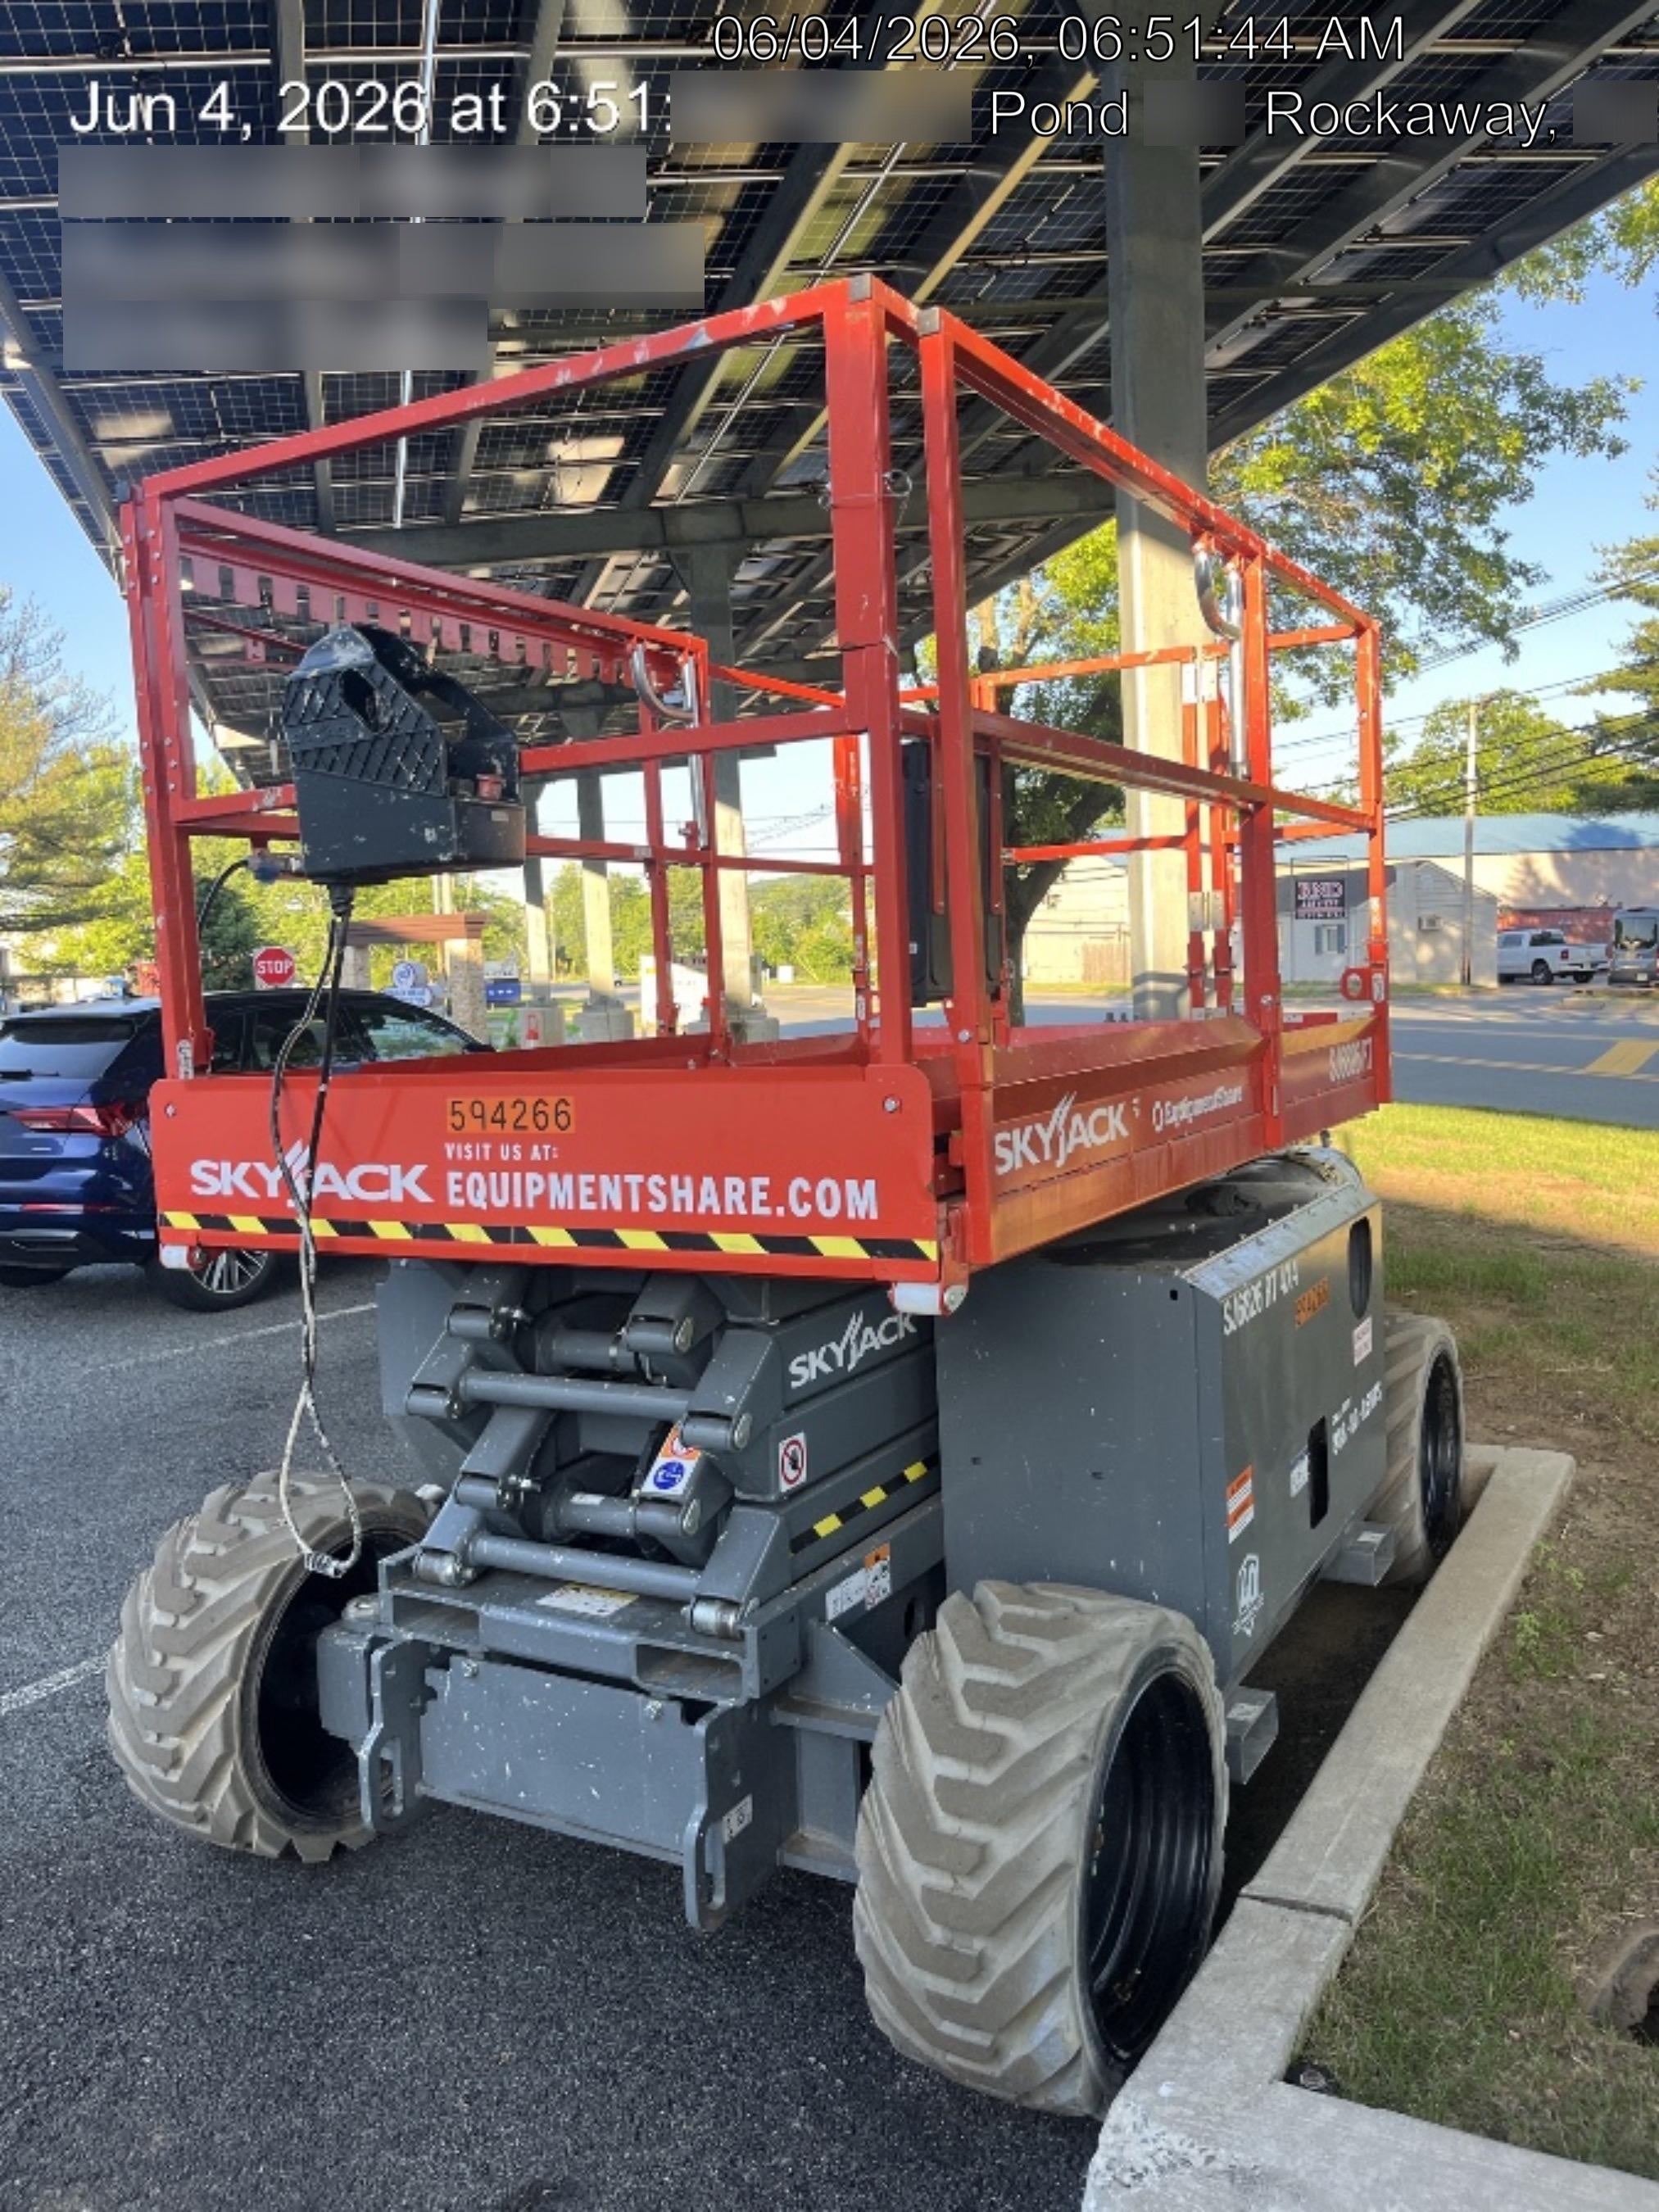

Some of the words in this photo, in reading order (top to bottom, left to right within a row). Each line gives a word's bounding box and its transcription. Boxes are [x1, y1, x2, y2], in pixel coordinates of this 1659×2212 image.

[257, 959, 292, 974] STOP
[450, 1098, 573, 1132] 594266
[994, 1091, 1129, 1176] SKYJACK
[189, 1139, 434, 1208] SKYJACK
[445, 1141, 492, 1162] VISIT
[500, 1143, 522, 1162] US
[446, 1172, 879, 1220] EQUIPMENTSHARE.COM
[788, 1310, 918, 1389] SKYJACK
